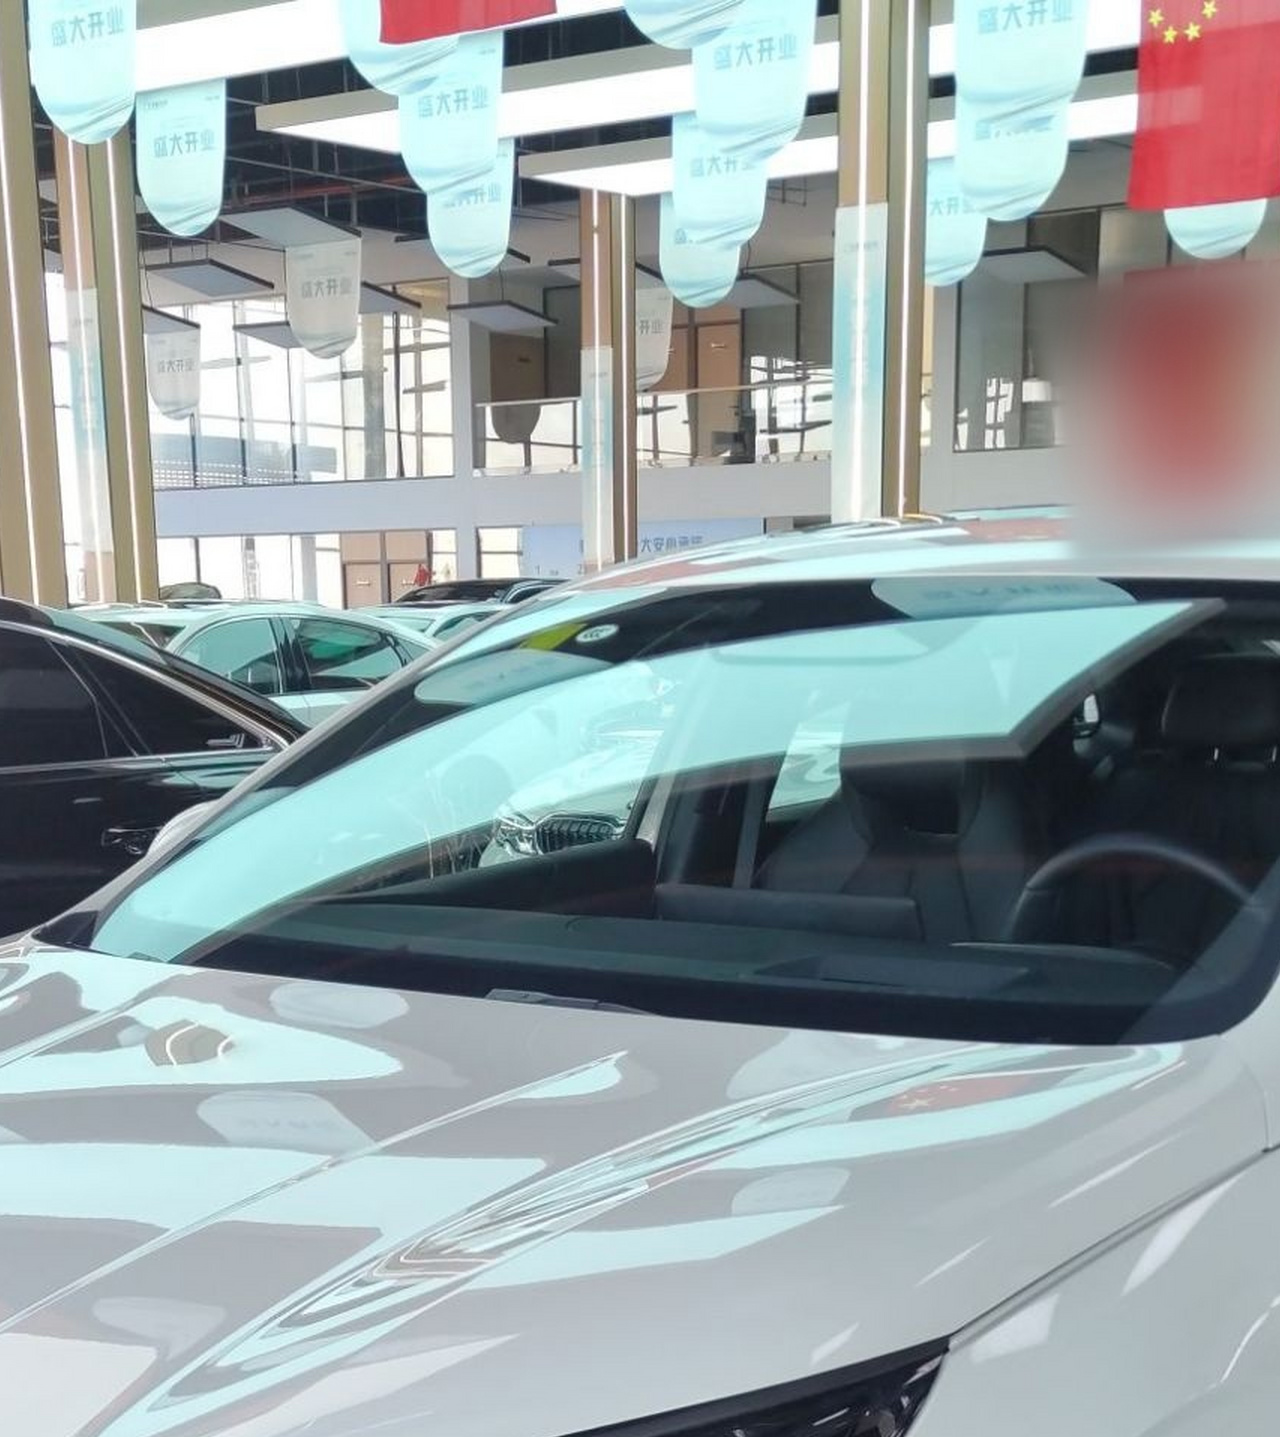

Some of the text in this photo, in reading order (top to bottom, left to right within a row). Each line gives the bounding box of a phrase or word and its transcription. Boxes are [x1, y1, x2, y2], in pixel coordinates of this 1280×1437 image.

[51, 6, 124, 47] 盛大开业
[714, 33, 798, 70] 盛大开业
[418, 85, 489, 118] 盛大开业
[154, 128, 217, 158] 盛大开业
